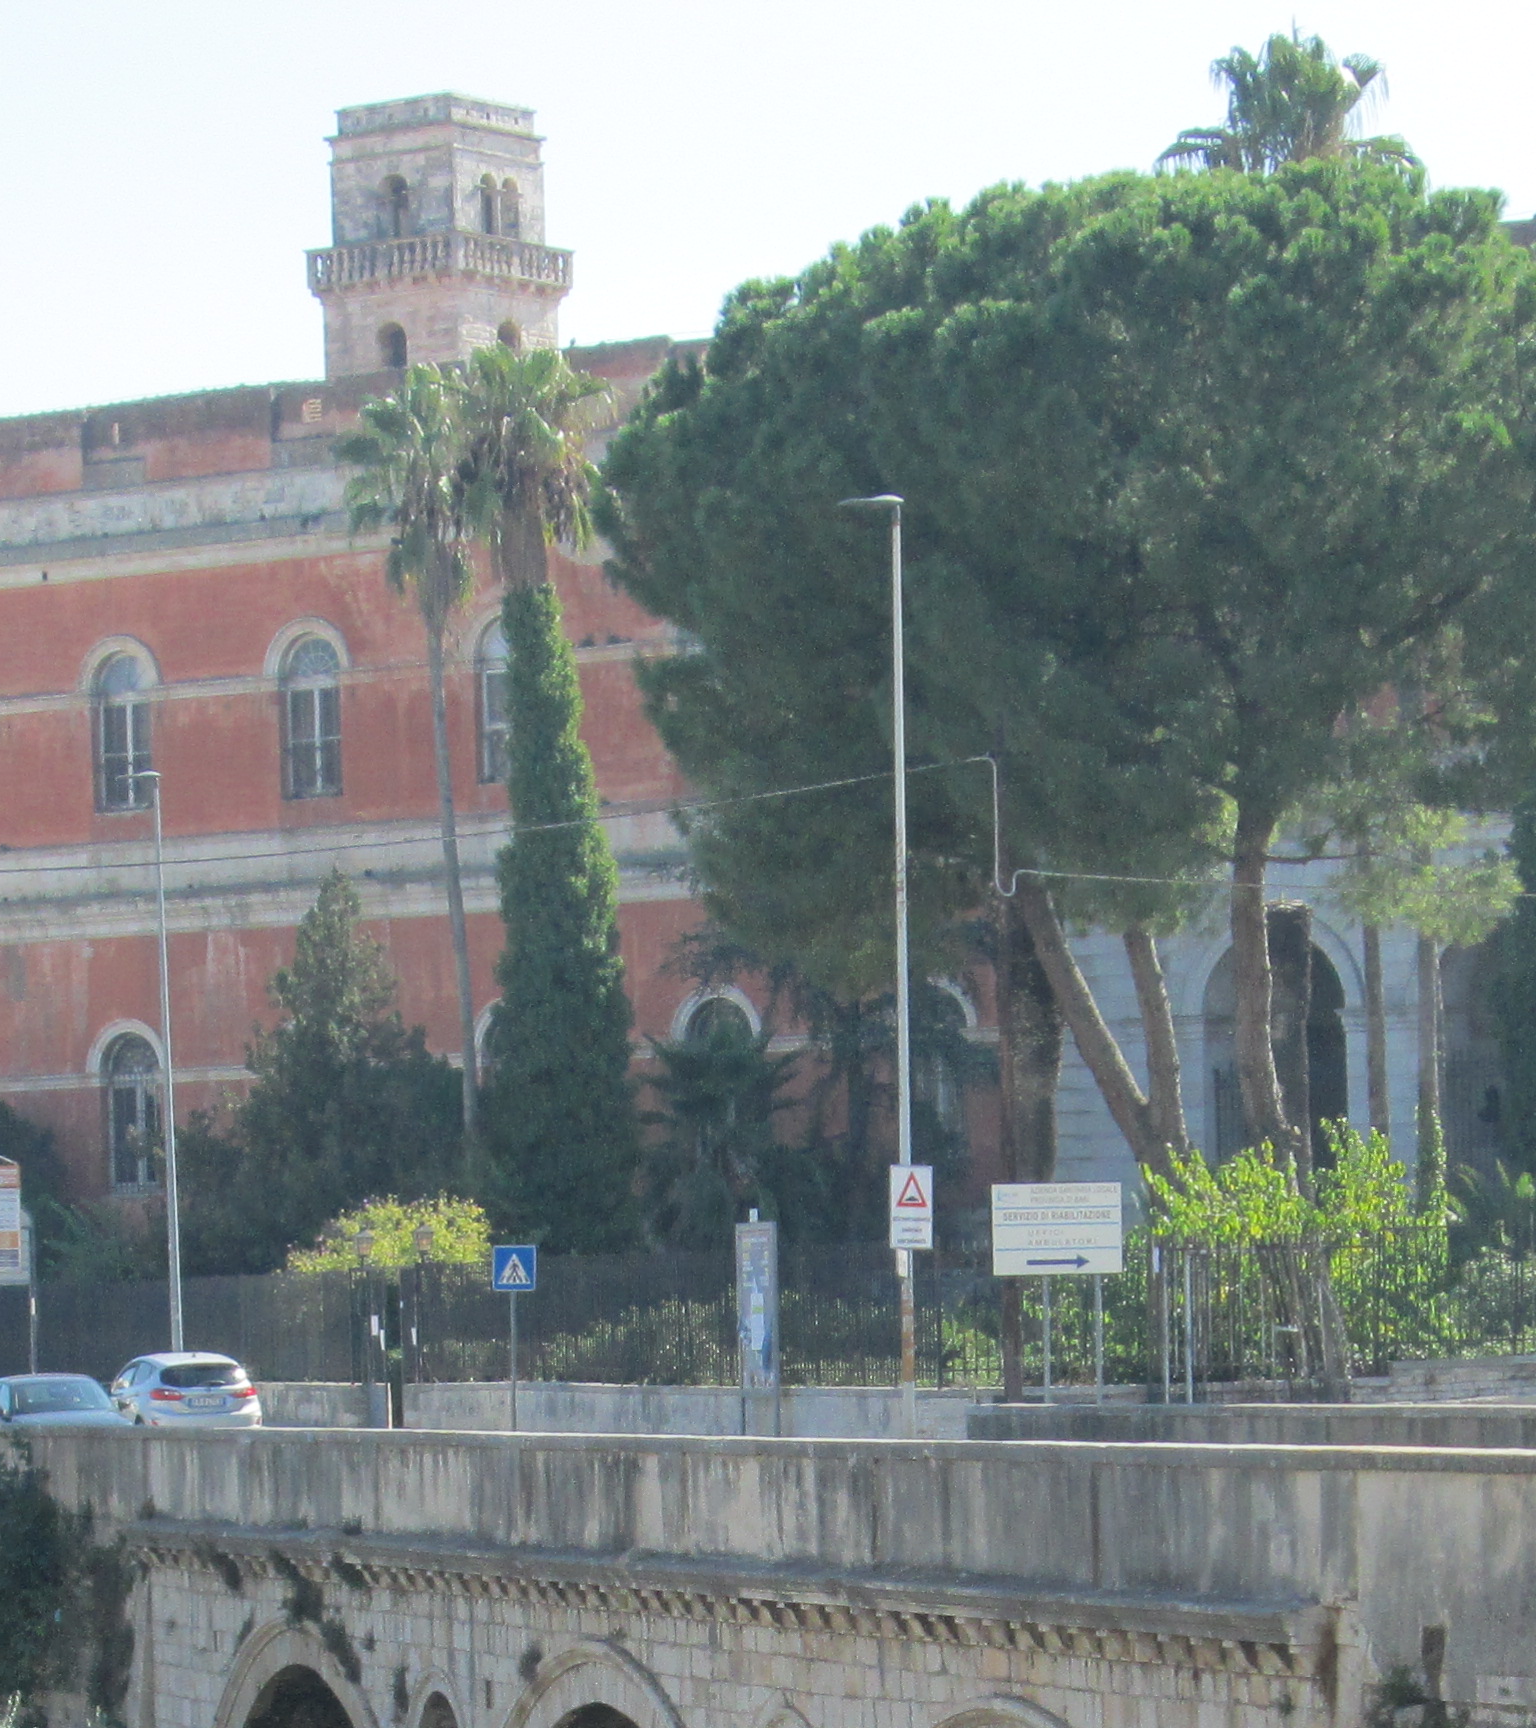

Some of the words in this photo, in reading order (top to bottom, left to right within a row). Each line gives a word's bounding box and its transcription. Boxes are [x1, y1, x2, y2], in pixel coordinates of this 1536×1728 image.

[1002, 1211, 1039, 1222] SERVIZIO
[1041, 1211, 1049, 1221] DI
[1051, 1210, 1112, 1221] RIABILITAZIONE
[1027, 1238, 1097, 1246] AMBULATORI
